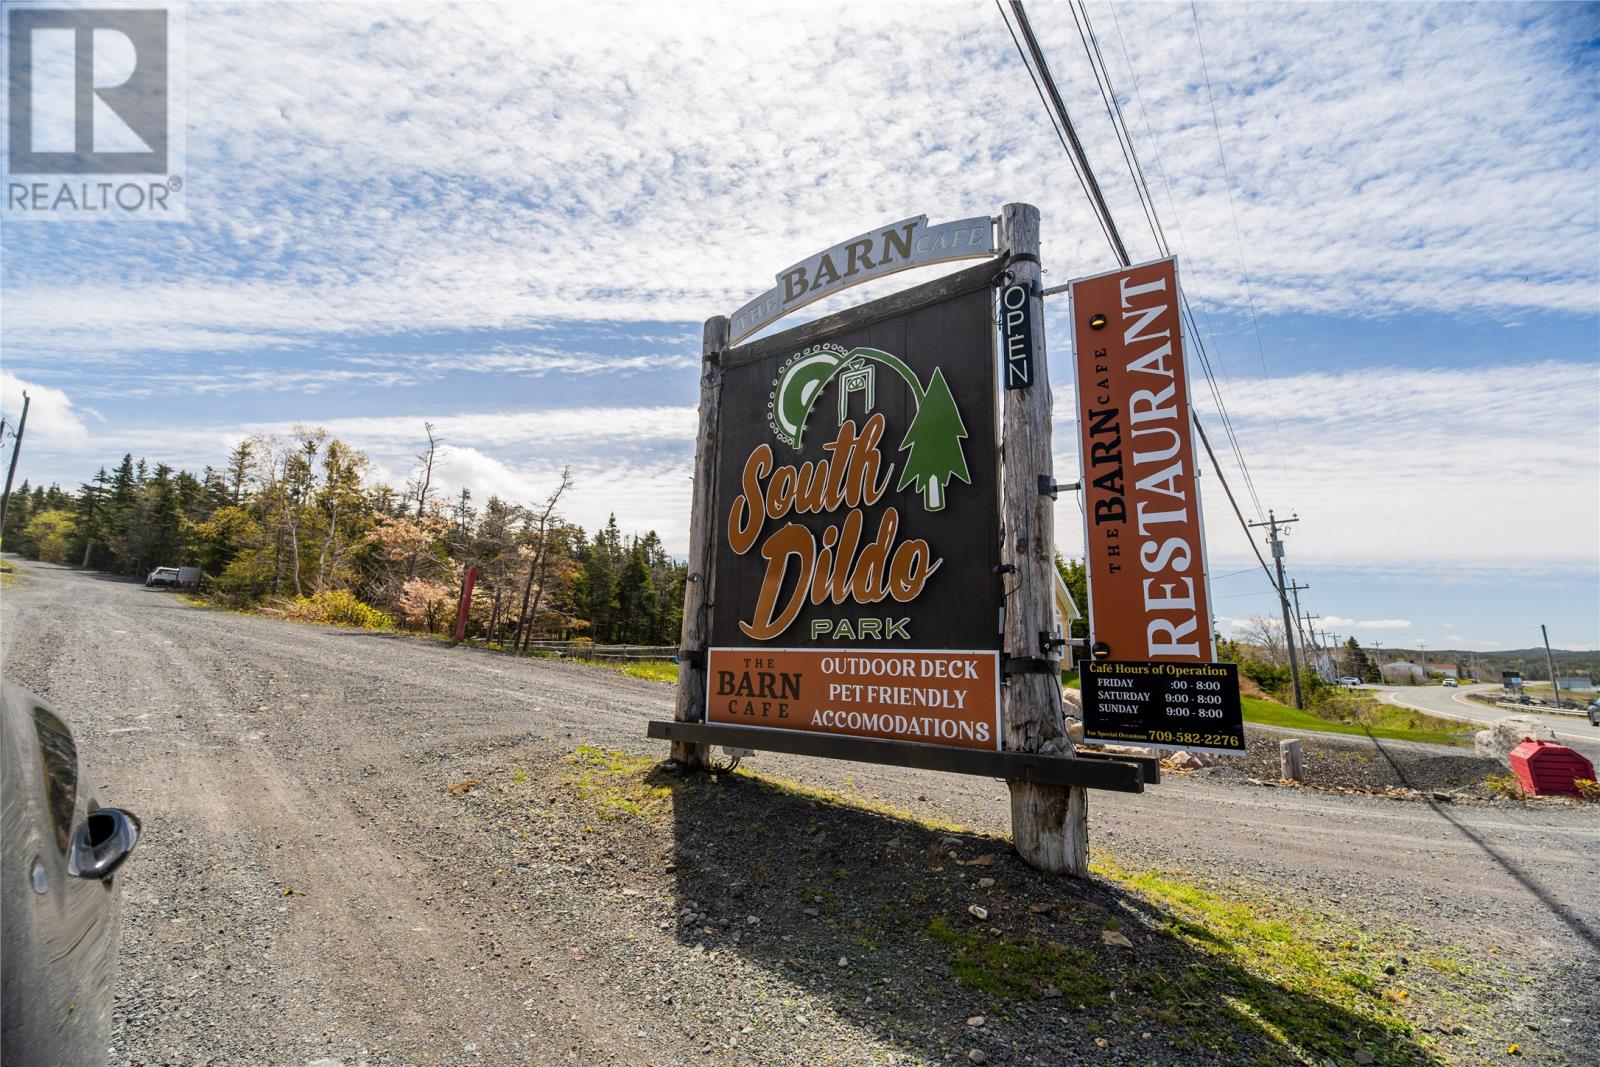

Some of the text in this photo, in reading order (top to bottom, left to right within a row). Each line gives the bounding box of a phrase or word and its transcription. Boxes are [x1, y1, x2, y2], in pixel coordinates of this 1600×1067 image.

[736, 222, 984, 330] THE BARN CAFE
[1004, 286, 1029, 384] OPEN
[1088, 348, 1126, 574] THE BARN CAFE
[1120, 276, 1200, 658] RESTAURANT
[728, 413, 894, 554] South
[739, 507, 943, 640] Dildo
[811, 617, 910, 640] PARK
[744, 658, 775, 669] THE
[821, 657, 979, 679] OUTDOOR DECK
[1090, 663, 1228, 677] Café Hours of Operation
[717, 670, 803, 700] BARN
[829, 684, 967, 709] PET FRIENDLY
[1097, 678, 1134, 687] FRIDAY
[1196, 681, 1221, 691] 8:00
[728, 700, 790, 719] CAFE
[1098, 691, 1151, 702] SATURDAY
[1165, 693, 1189, 703] 9:00
[1197, 695, 1222, 704] 8:00
[1099, 703, 1139, 714] SUNDAY
[1166, 707, 1190, 717] 9:00
[1198, 708, 1223, 719] 8:00
[811, 709, 990, 742] ACCOMODATIONS
[1097, 730, 1118, 738] Special
[1149, 730, 1239, 747] 709-582-2276
